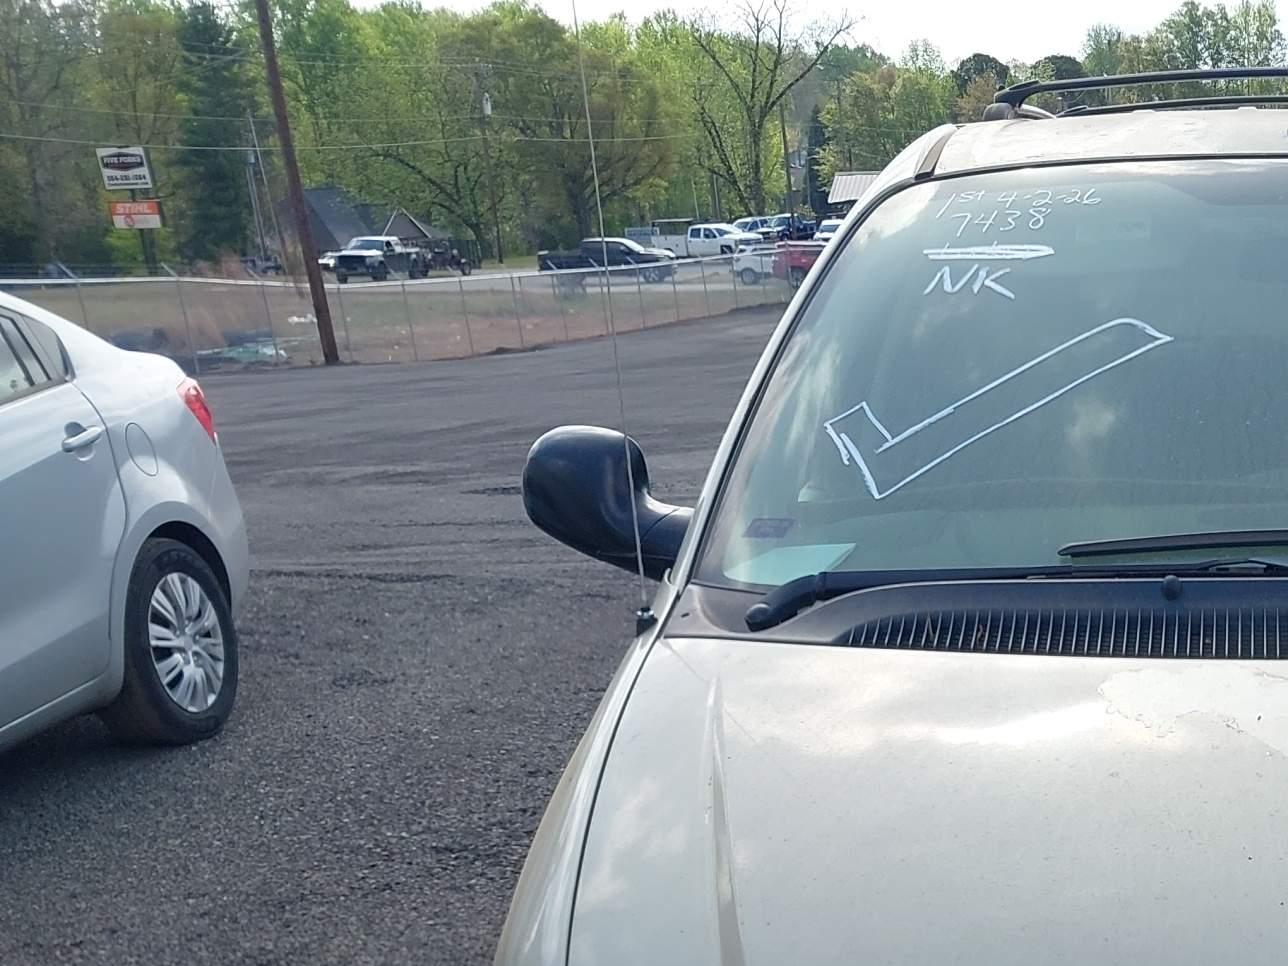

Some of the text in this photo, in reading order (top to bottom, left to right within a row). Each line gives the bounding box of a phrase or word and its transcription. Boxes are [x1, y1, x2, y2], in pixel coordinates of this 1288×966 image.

[116, 203, 148, 214] STIHL
[998, 188, 1102, 208] 4-2-26
[951, 207, 1051, 237] 7438
[923, 264, 1015, 300] NK
